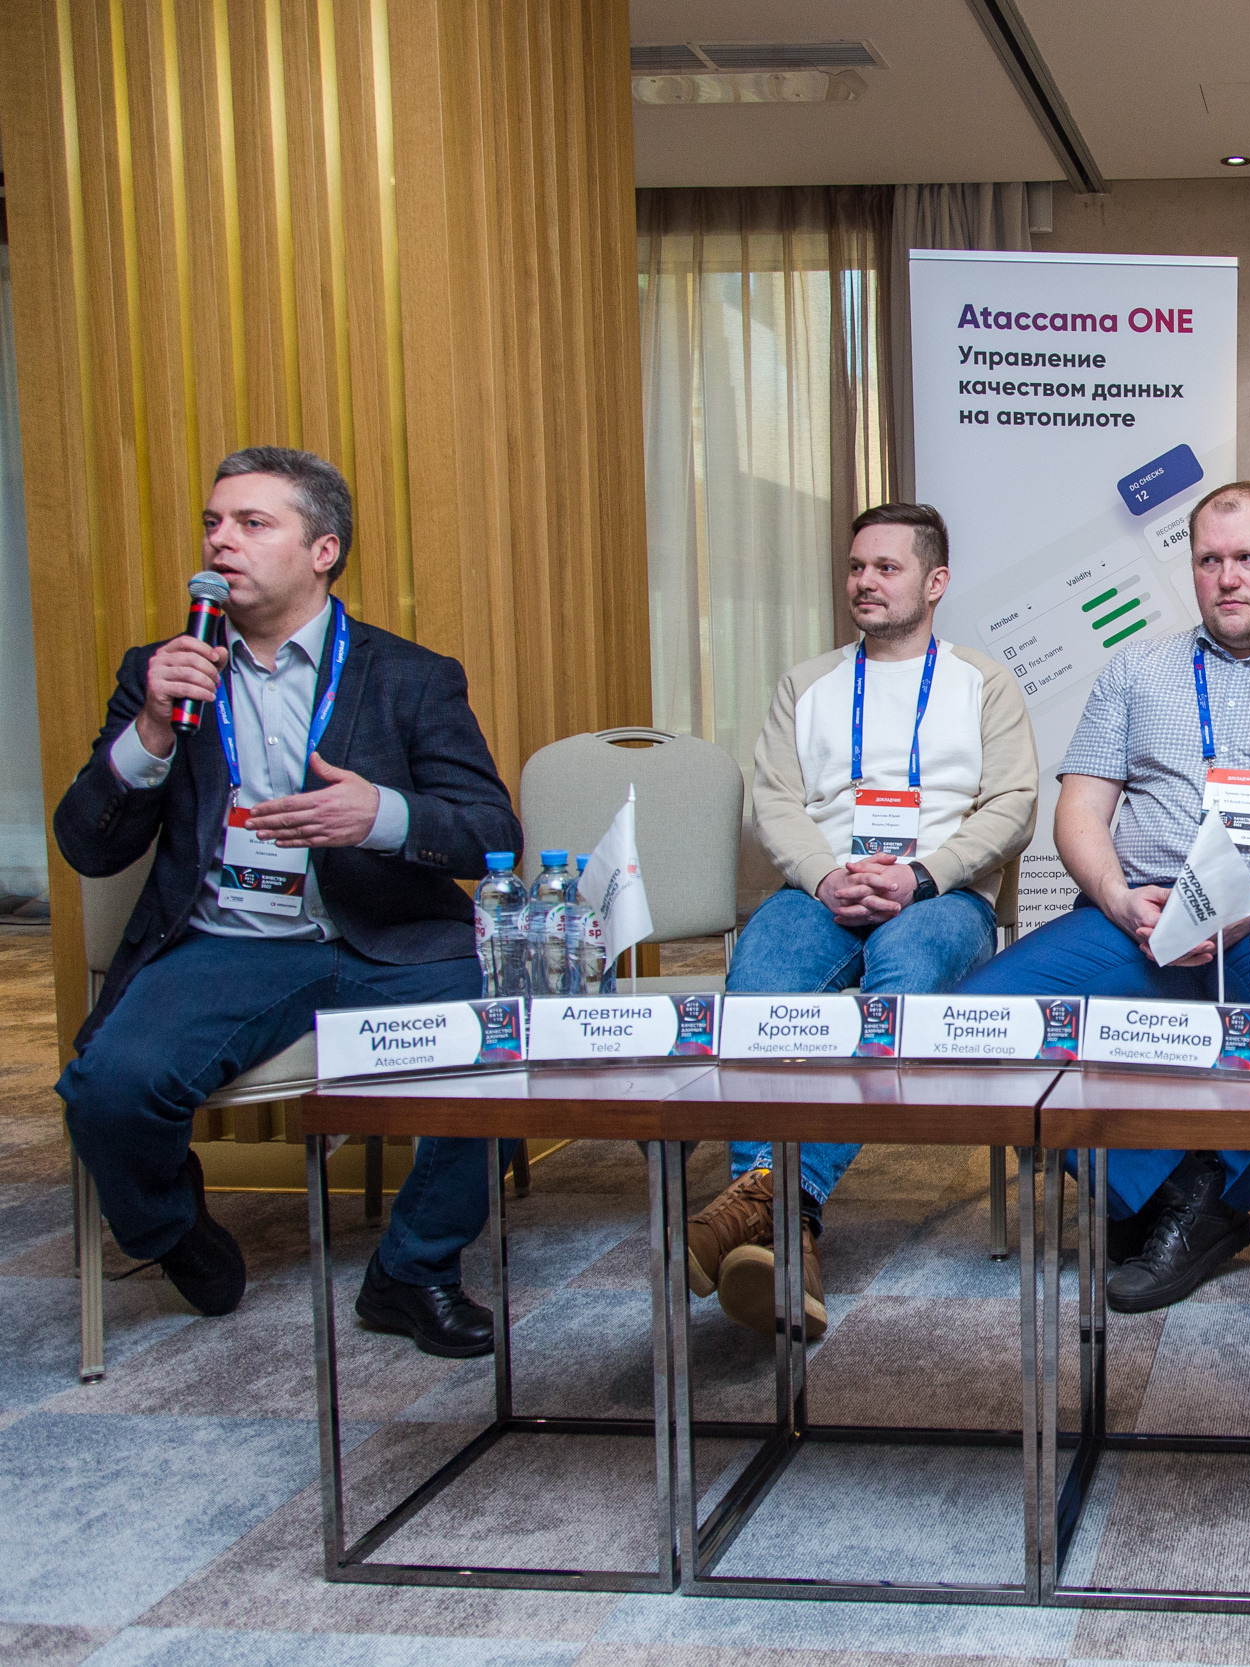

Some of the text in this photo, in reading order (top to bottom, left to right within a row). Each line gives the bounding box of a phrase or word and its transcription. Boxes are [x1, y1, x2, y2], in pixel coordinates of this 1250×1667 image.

[957, 303, 1194, 334] Ataccama ONE
[957, 345, 1107, 371] Управление
[958, 379, 1185, 401] качеством данных
[958, 408, 1136, 428] на автопилоте
[1129, 467, 1165, 492] DQ CHECKS
[1135, 490, 1150, 503] 12
[1155, 517, 1185, 538] RECORDS
[1163, 539, 1170, 548] 4
[1066, 569, 1093, 588] Validity
[990, 611, 1020, 633] Attribute
[1018, 635, 1038, 651] email
[1028, 644, 1064, 669] first_name
[1038, 662, 1074, 687] last_name
[1019, 871, 1071, 880] глоссари
[1018, 887, 1048, 895] вание
[1059, 887, 1079, 896] про
[1179, 877, 1208, 922] СИСТЕМЫ
[1183, 863, 1217, 918] ОТКРЫТЫЕ
[1018, 904, 1042, 913] ринг
[562, 1006, 652, 1021] Алевтина
[769, 1004, 822, 1022] Юрий
[942, 1006, 1010, 1024] Андрей
[1126, 1009, 1189, 1031] Сергей
[359, 1015, 448, 1036] Алексей
[580, 1022, 634, 1037] Тинас
[757, 1021, 830, 1038] Кротков
[944, 1022, 1008, 1041] Трянин
[370, 1033, 438, 1052] Ильин
[1099, 1026, 1213, 1048] Васильчиков
[590, 1042, 621, 1053] Tele2
[747, 1042, 839, 1053] «Яндекс.Маркет»
[933, 1043, 1016, 1056] X5 Retail Group
[1108, 1048, 1199, 1063] «Яндекс.Маркет»
[374, 1053, 436, 1068] Ataccama
